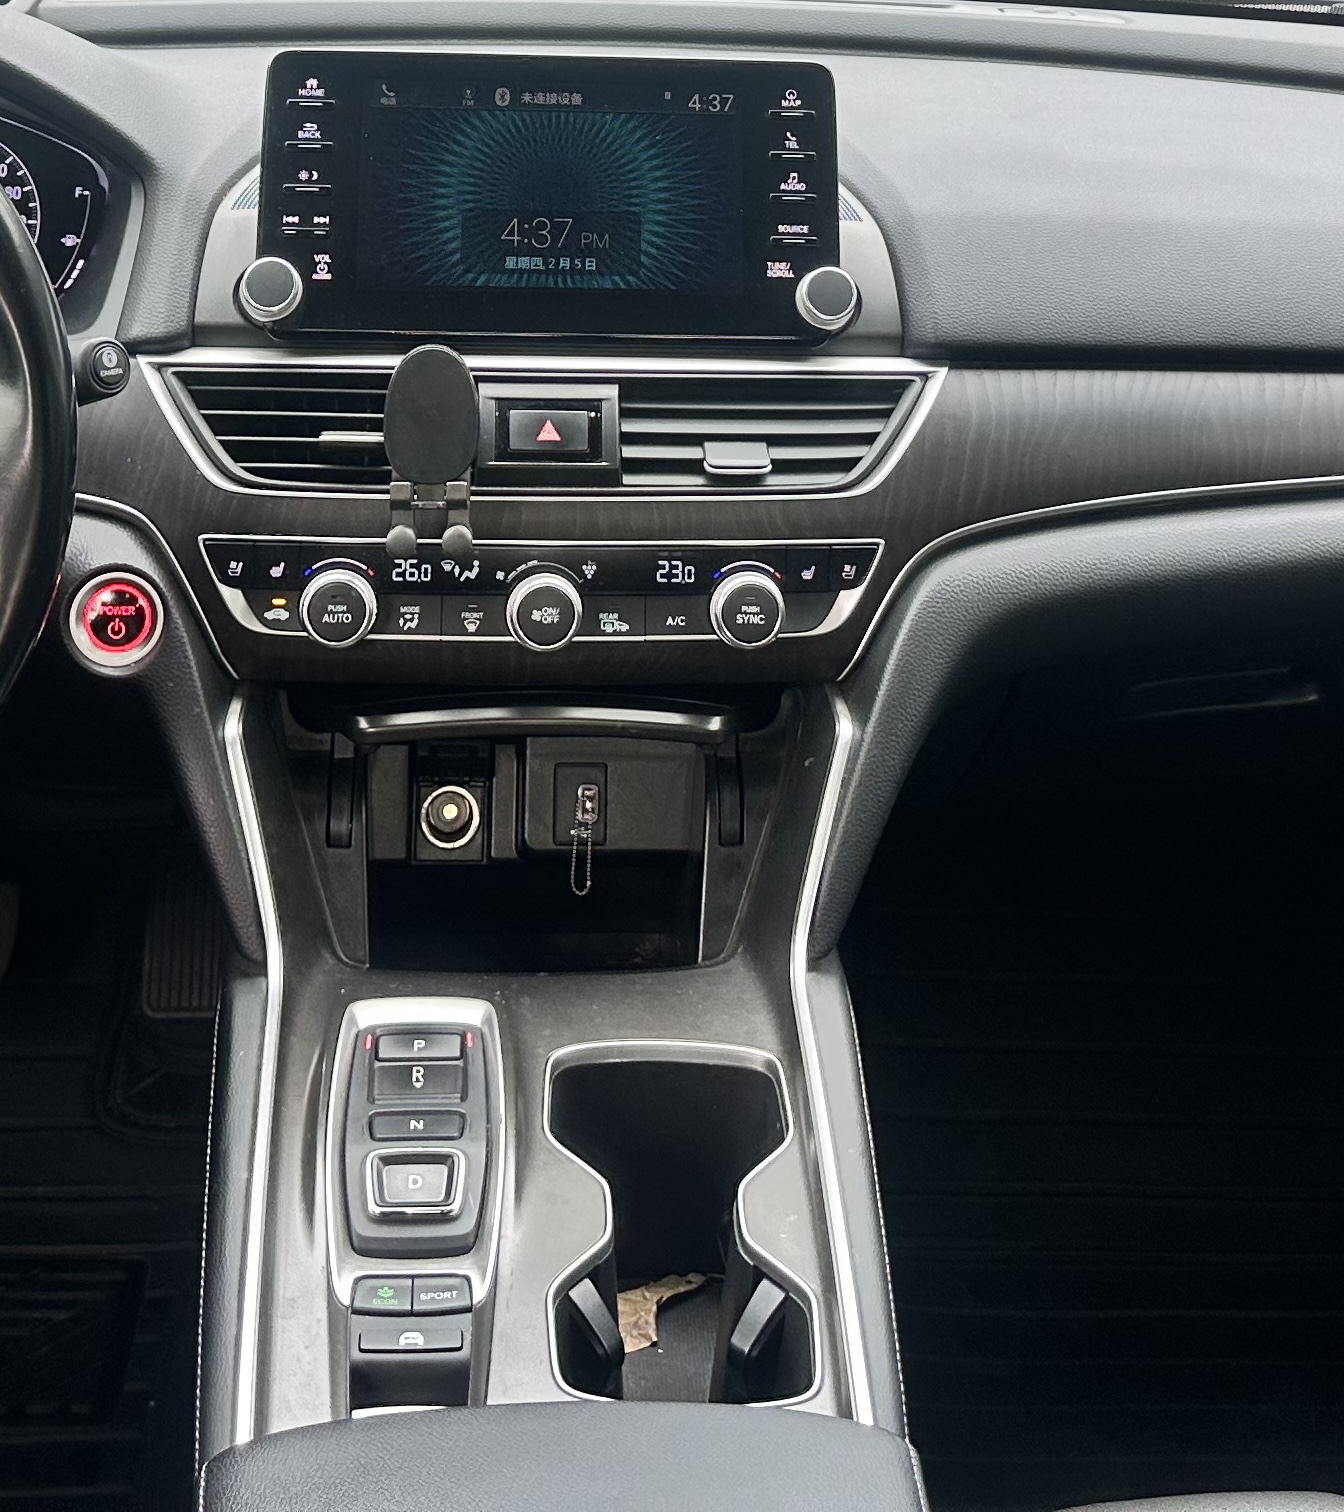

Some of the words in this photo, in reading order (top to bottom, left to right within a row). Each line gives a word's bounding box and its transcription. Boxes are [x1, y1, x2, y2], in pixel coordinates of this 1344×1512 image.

[298, 88, 325, 97] HOME
[520, 92, 583, 105] 未连接设备
[687, 93, 735, 112] 4:37
[781, 99, 802, 107] MAP
[297, 130, 321, 139] BACK
[784, 140, 799, 149] TEL
[779, 182, 806, 191] AUDIO
[74, 187, 83, 198] F
[500, 217, 573, 248] 4:37
[580, 232, 609, 249] PM
[777, 225, 809, 234] SOURCE
[313, 253, 332, 263] VOL
[766, 269, 795, 278] SCROLL
[100, 368, 123, 378] CAMERA
[392, 559, 431, 583] 26.0
[656, 560, 695, 584] 23.0
[99, 605, 136, 616] POWER
[400, 606, 420, 614] MODE
[542, 606, 560, 616] ON/
[741, 605, 761, 613] PUSH
[321, 613, 352, 624] AUTO
[461, 611, 484, 620] FRONT
[542, 614, 560, 624] OFF
[666, 615, 686, 626] A/C
[736, 614, 765, 625] SYNC
[413, 1039, 426, 1052] P
[412, 1067, 424, 1083] R
[409, 1119, 424, 1130] N
[408, 1175, 422, 1189] D
[420, 1290, 457, 1302] SPORT
[372, 1298, 398, 1306] ECON
